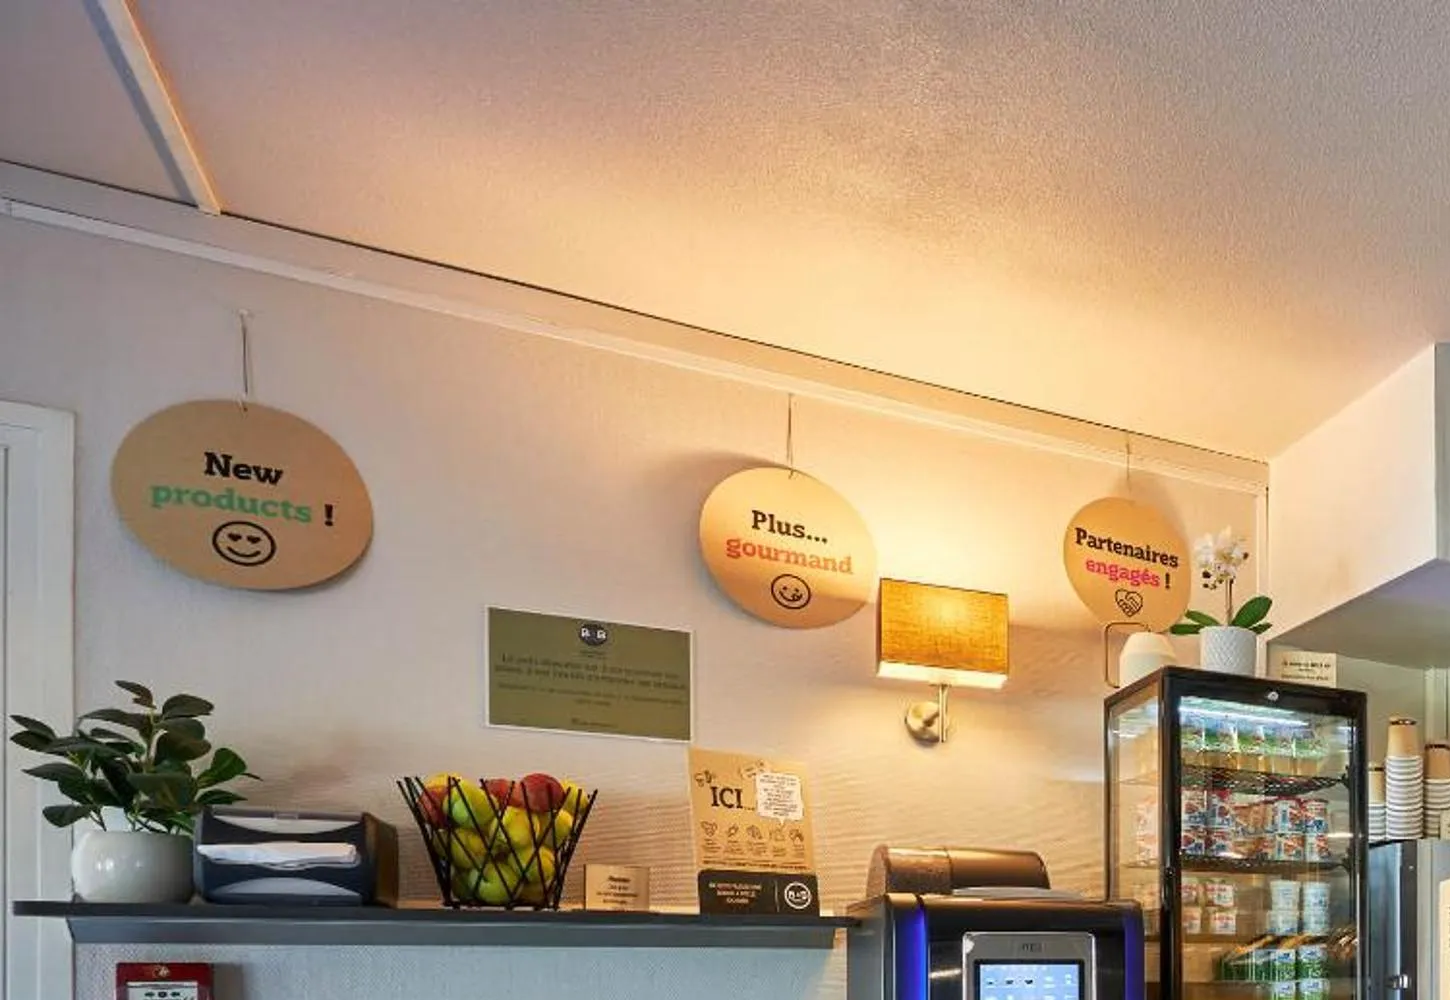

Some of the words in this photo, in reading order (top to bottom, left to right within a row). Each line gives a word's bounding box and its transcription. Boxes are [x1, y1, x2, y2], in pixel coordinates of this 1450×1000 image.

[204, 451, 283, 485] New
[150, 484, 312, 523] products
[323, 503, 335, 526] !
[751, 509, 828, 544] Plus...
[726, 537, 854, 575] gourmand
[1075, 527, 1179, 569] Partenaires
[1085, 559, 1161, 587] engagés
